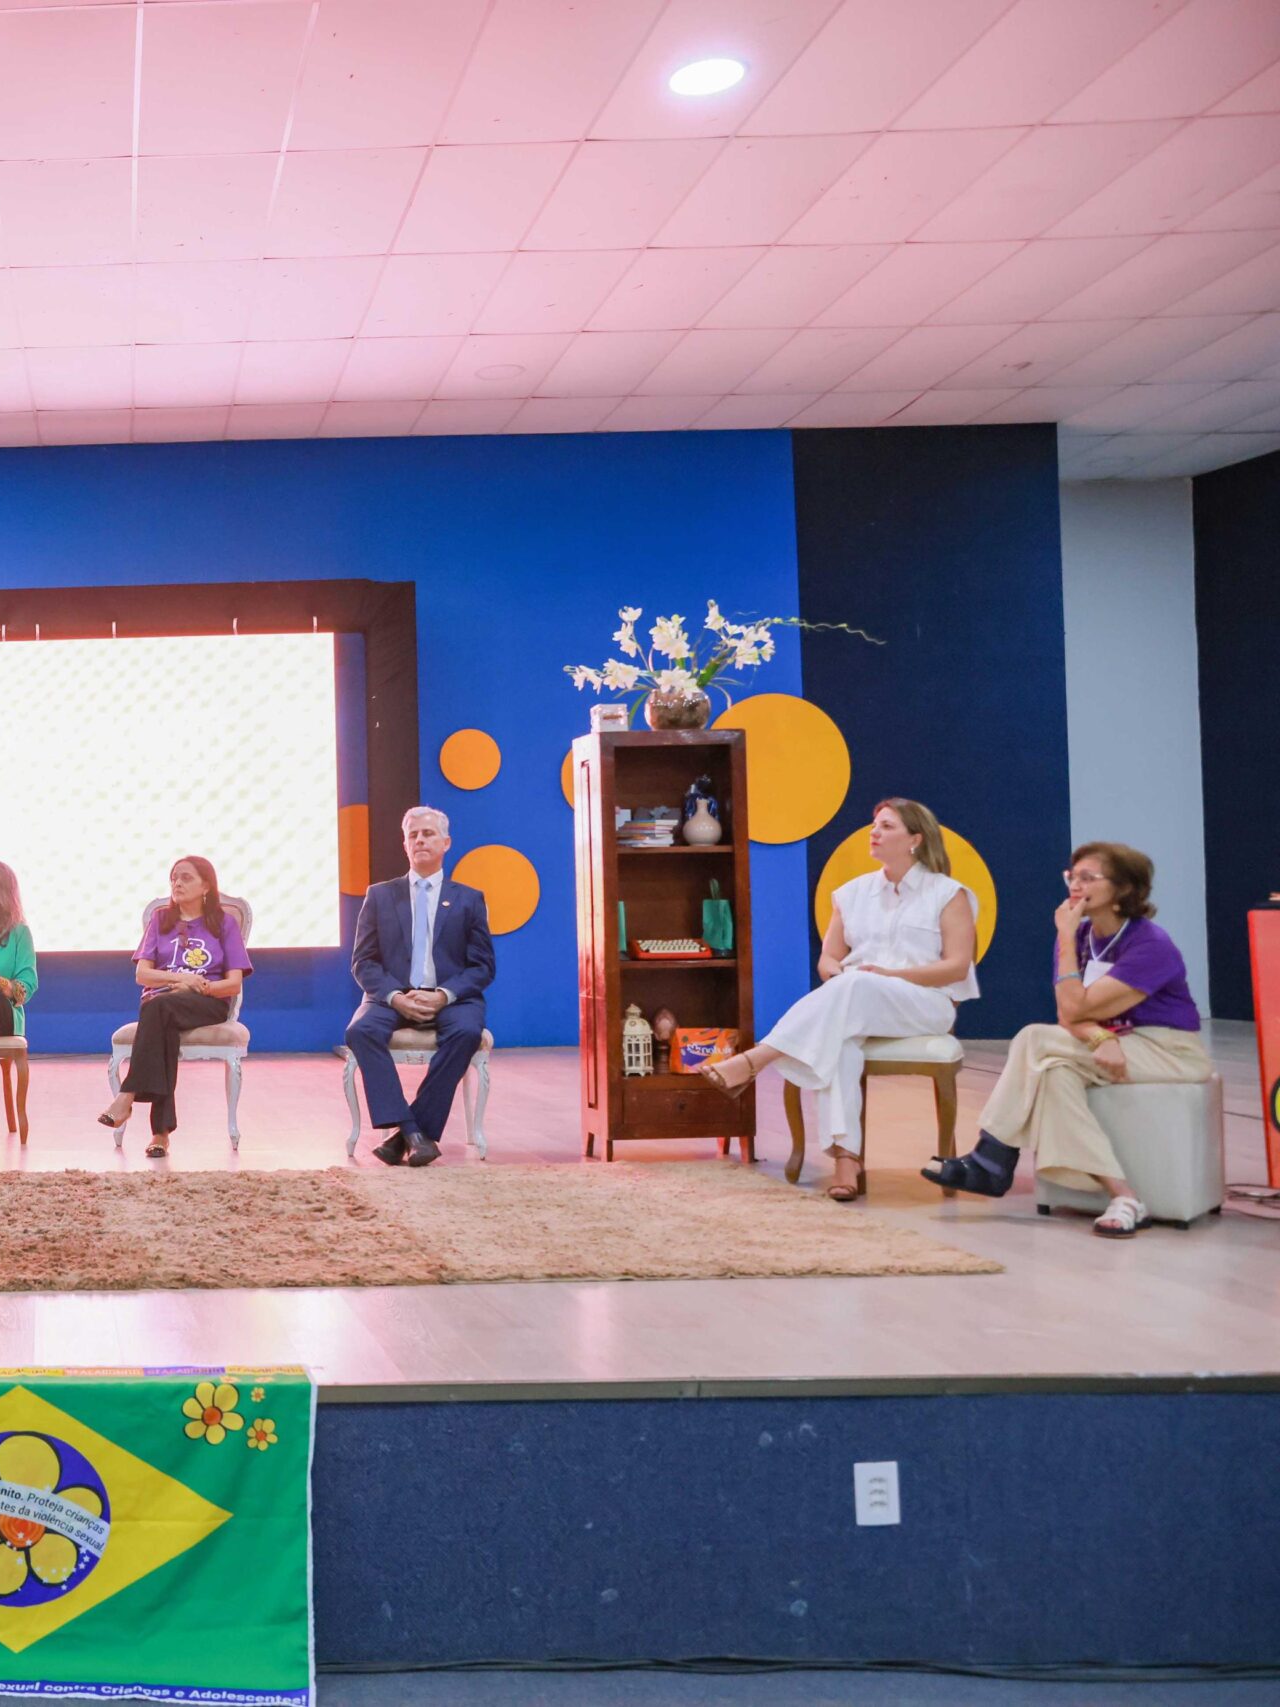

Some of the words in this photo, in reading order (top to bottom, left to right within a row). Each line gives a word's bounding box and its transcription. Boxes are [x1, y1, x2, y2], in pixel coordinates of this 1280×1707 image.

[18, 1506, 31, 1516] da
[33, 1509, 74, 1533] violência
[27, 1492, 63, 1513] Proteja
[65, 1507, 105, 1535] crianças
[101, 1685, 170, 1697] Crianças
[175, 1690, 185, 1698] e
[189, 1690, 307, 1706] Adolescentes!
